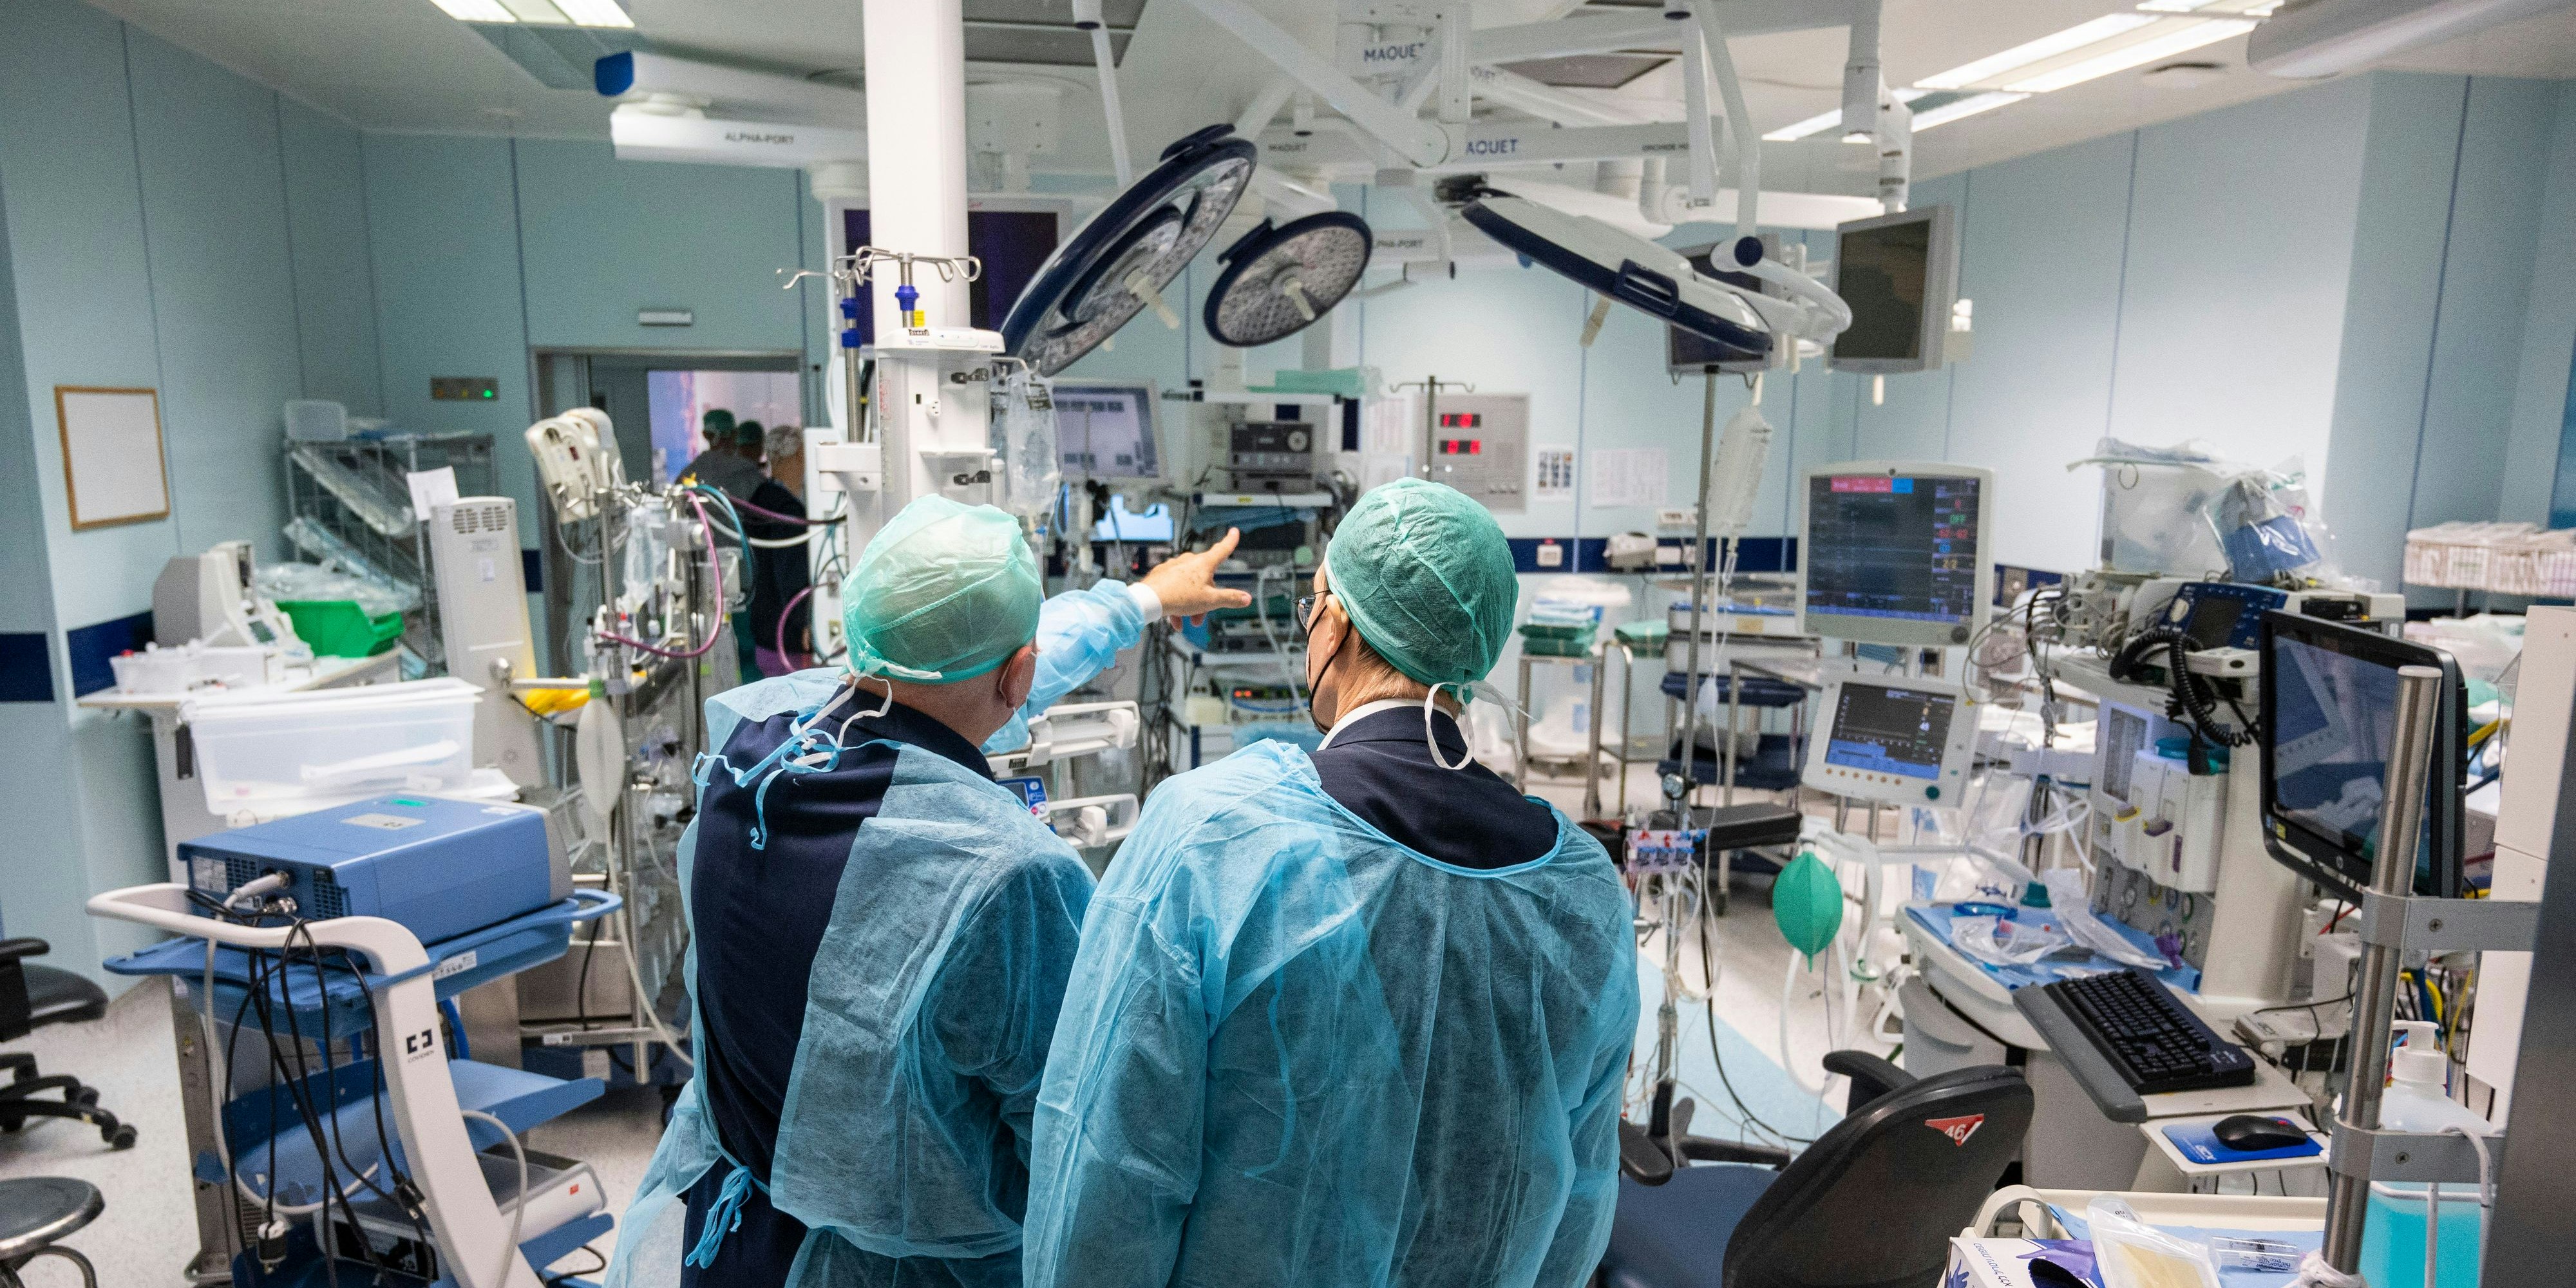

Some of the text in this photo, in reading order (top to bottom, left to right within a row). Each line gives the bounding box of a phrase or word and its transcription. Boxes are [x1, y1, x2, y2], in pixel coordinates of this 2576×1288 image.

[724, 132, 795, 144] ALPHA-PORT
[1268, 144, 1307, 153] MAQUET
[1466, 138, 1519, 155] AQUET
[1373, 239, 1423, 249] PHA-PORT
[1944, 1124, 1967, 1141] 46
